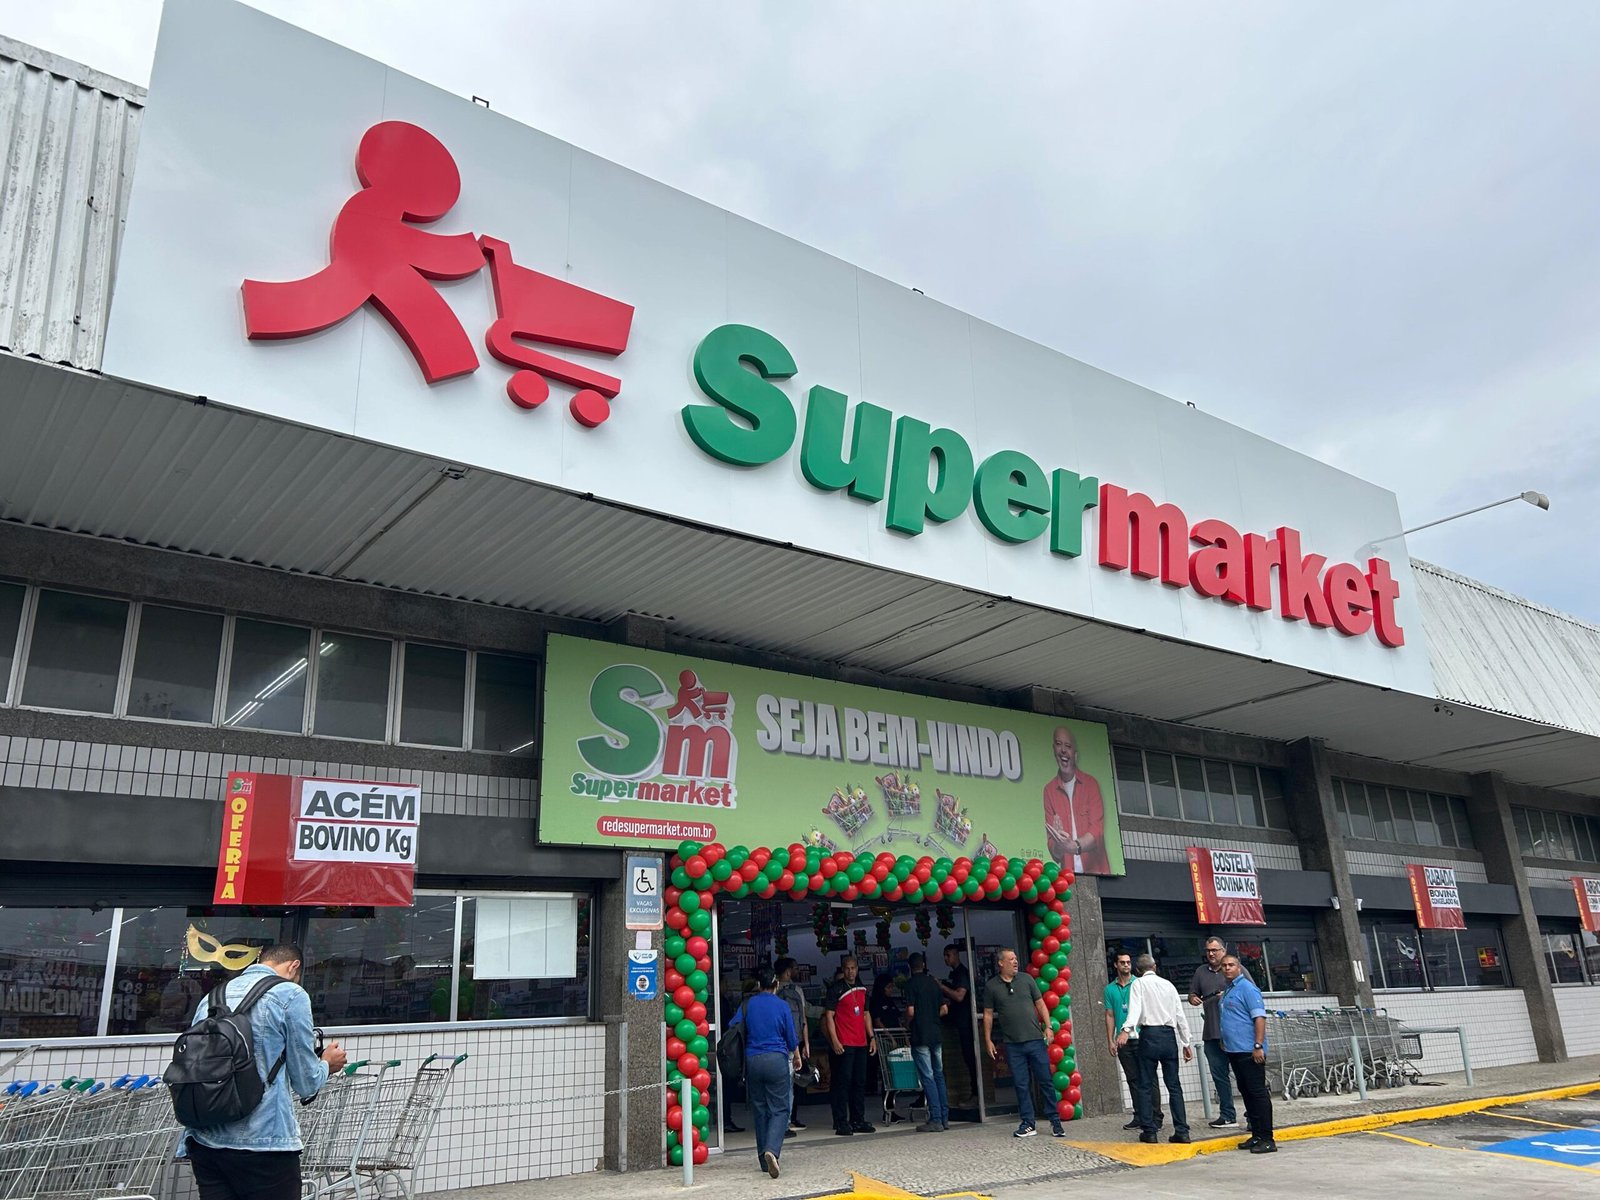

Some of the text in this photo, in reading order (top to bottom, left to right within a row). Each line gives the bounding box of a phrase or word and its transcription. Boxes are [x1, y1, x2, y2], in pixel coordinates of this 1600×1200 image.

[682, 324, 1405, 649] Supermarket
[756, 694, 1022, 781] SEJA BEM-VINDO
[304, 787, 416, 821] ACÉM
[570, 772, 735, 808] Supermarket
[299, 824, 412, 860] BOVINO Kg
[602, 818, 713, 839] redesupermarket.com.br
[220, 797, 248, 899] OFERTA
[1212, 852, 1253, 873] COSTELA
[1191, 862, 1206, 922] OFERTA
[1215, 876, 1256, 897] BOVINA Kg
[1425, 868, 1455, 887] RABADA
[1429, 889, 1458, 898] BOVINA
[31, 948, 77, 957] OFERTA
